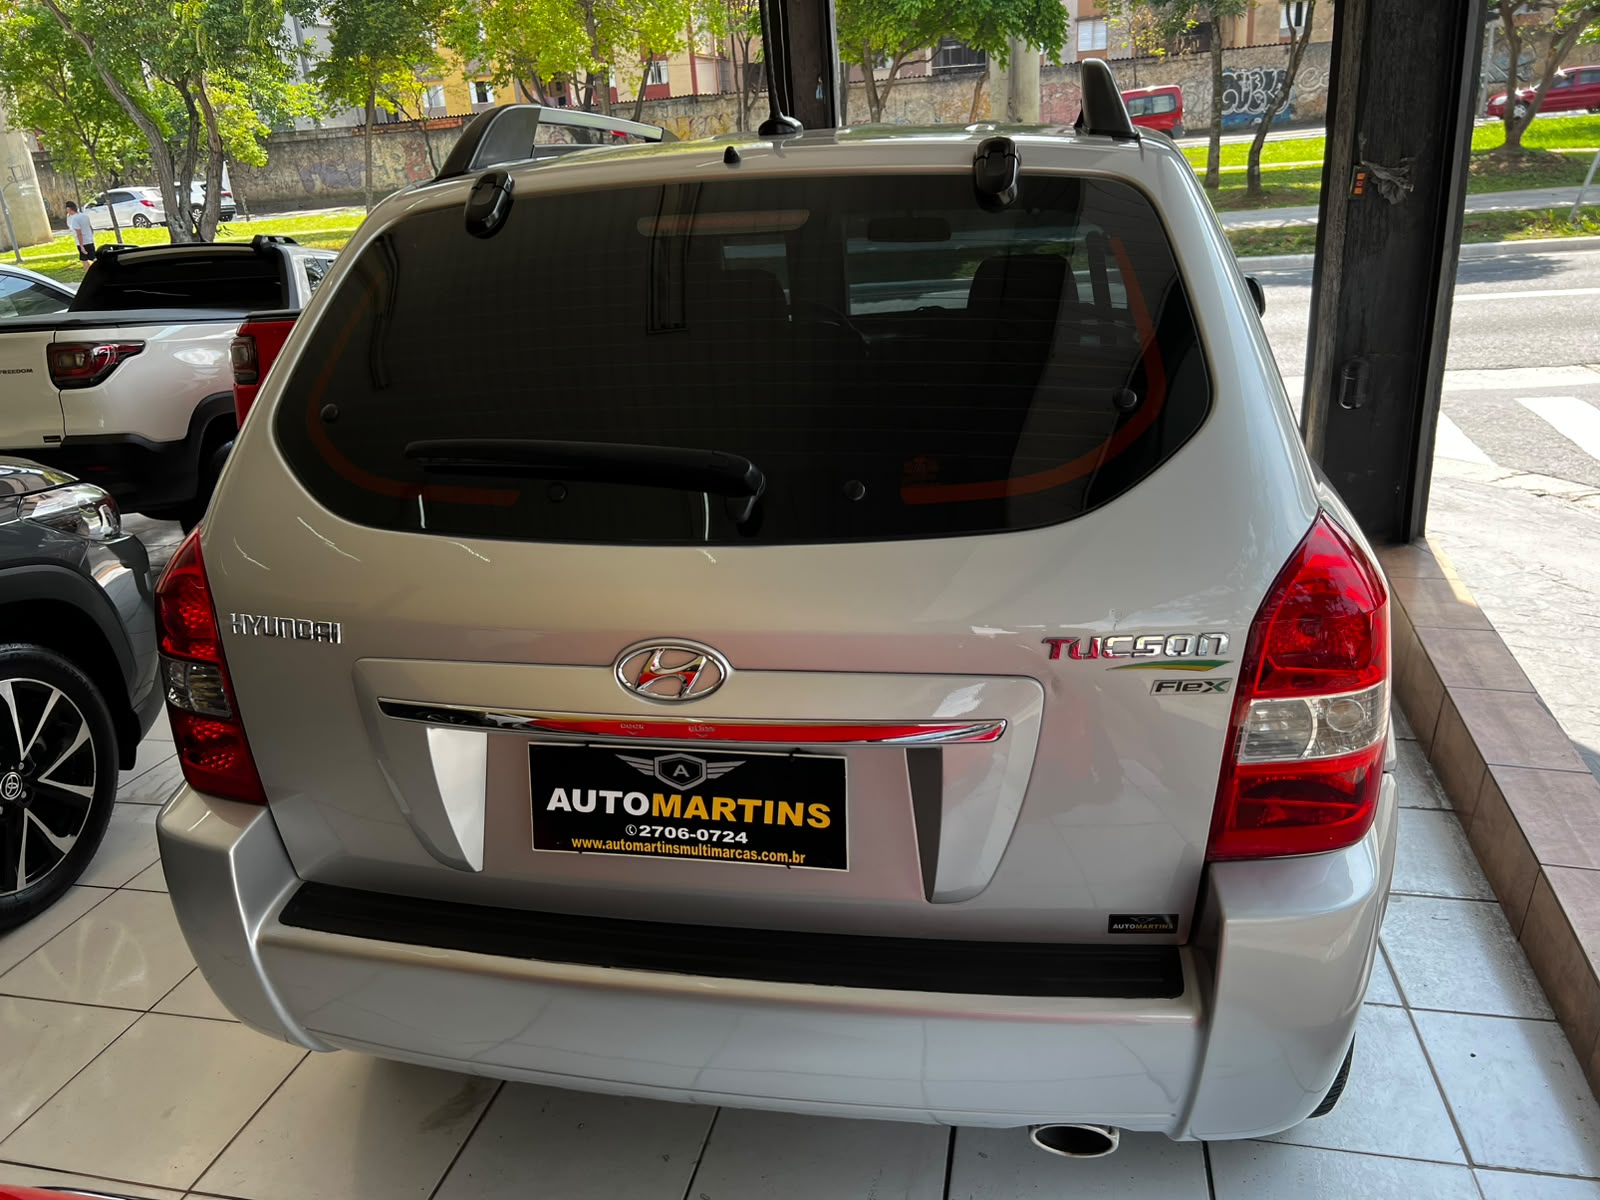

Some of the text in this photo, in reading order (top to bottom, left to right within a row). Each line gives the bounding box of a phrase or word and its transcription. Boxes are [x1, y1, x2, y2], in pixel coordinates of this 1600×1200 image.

[230, 612, 341, 644] HYUNDAI
[1042, 632, 1230, 660] TUCSON
[546, 787, 831, 829] AUTOMARTINS
[638, 825, 748, 844] 2706-0724
[571, 836, 806, 864] www.automartinsmultimarcas.com.br
